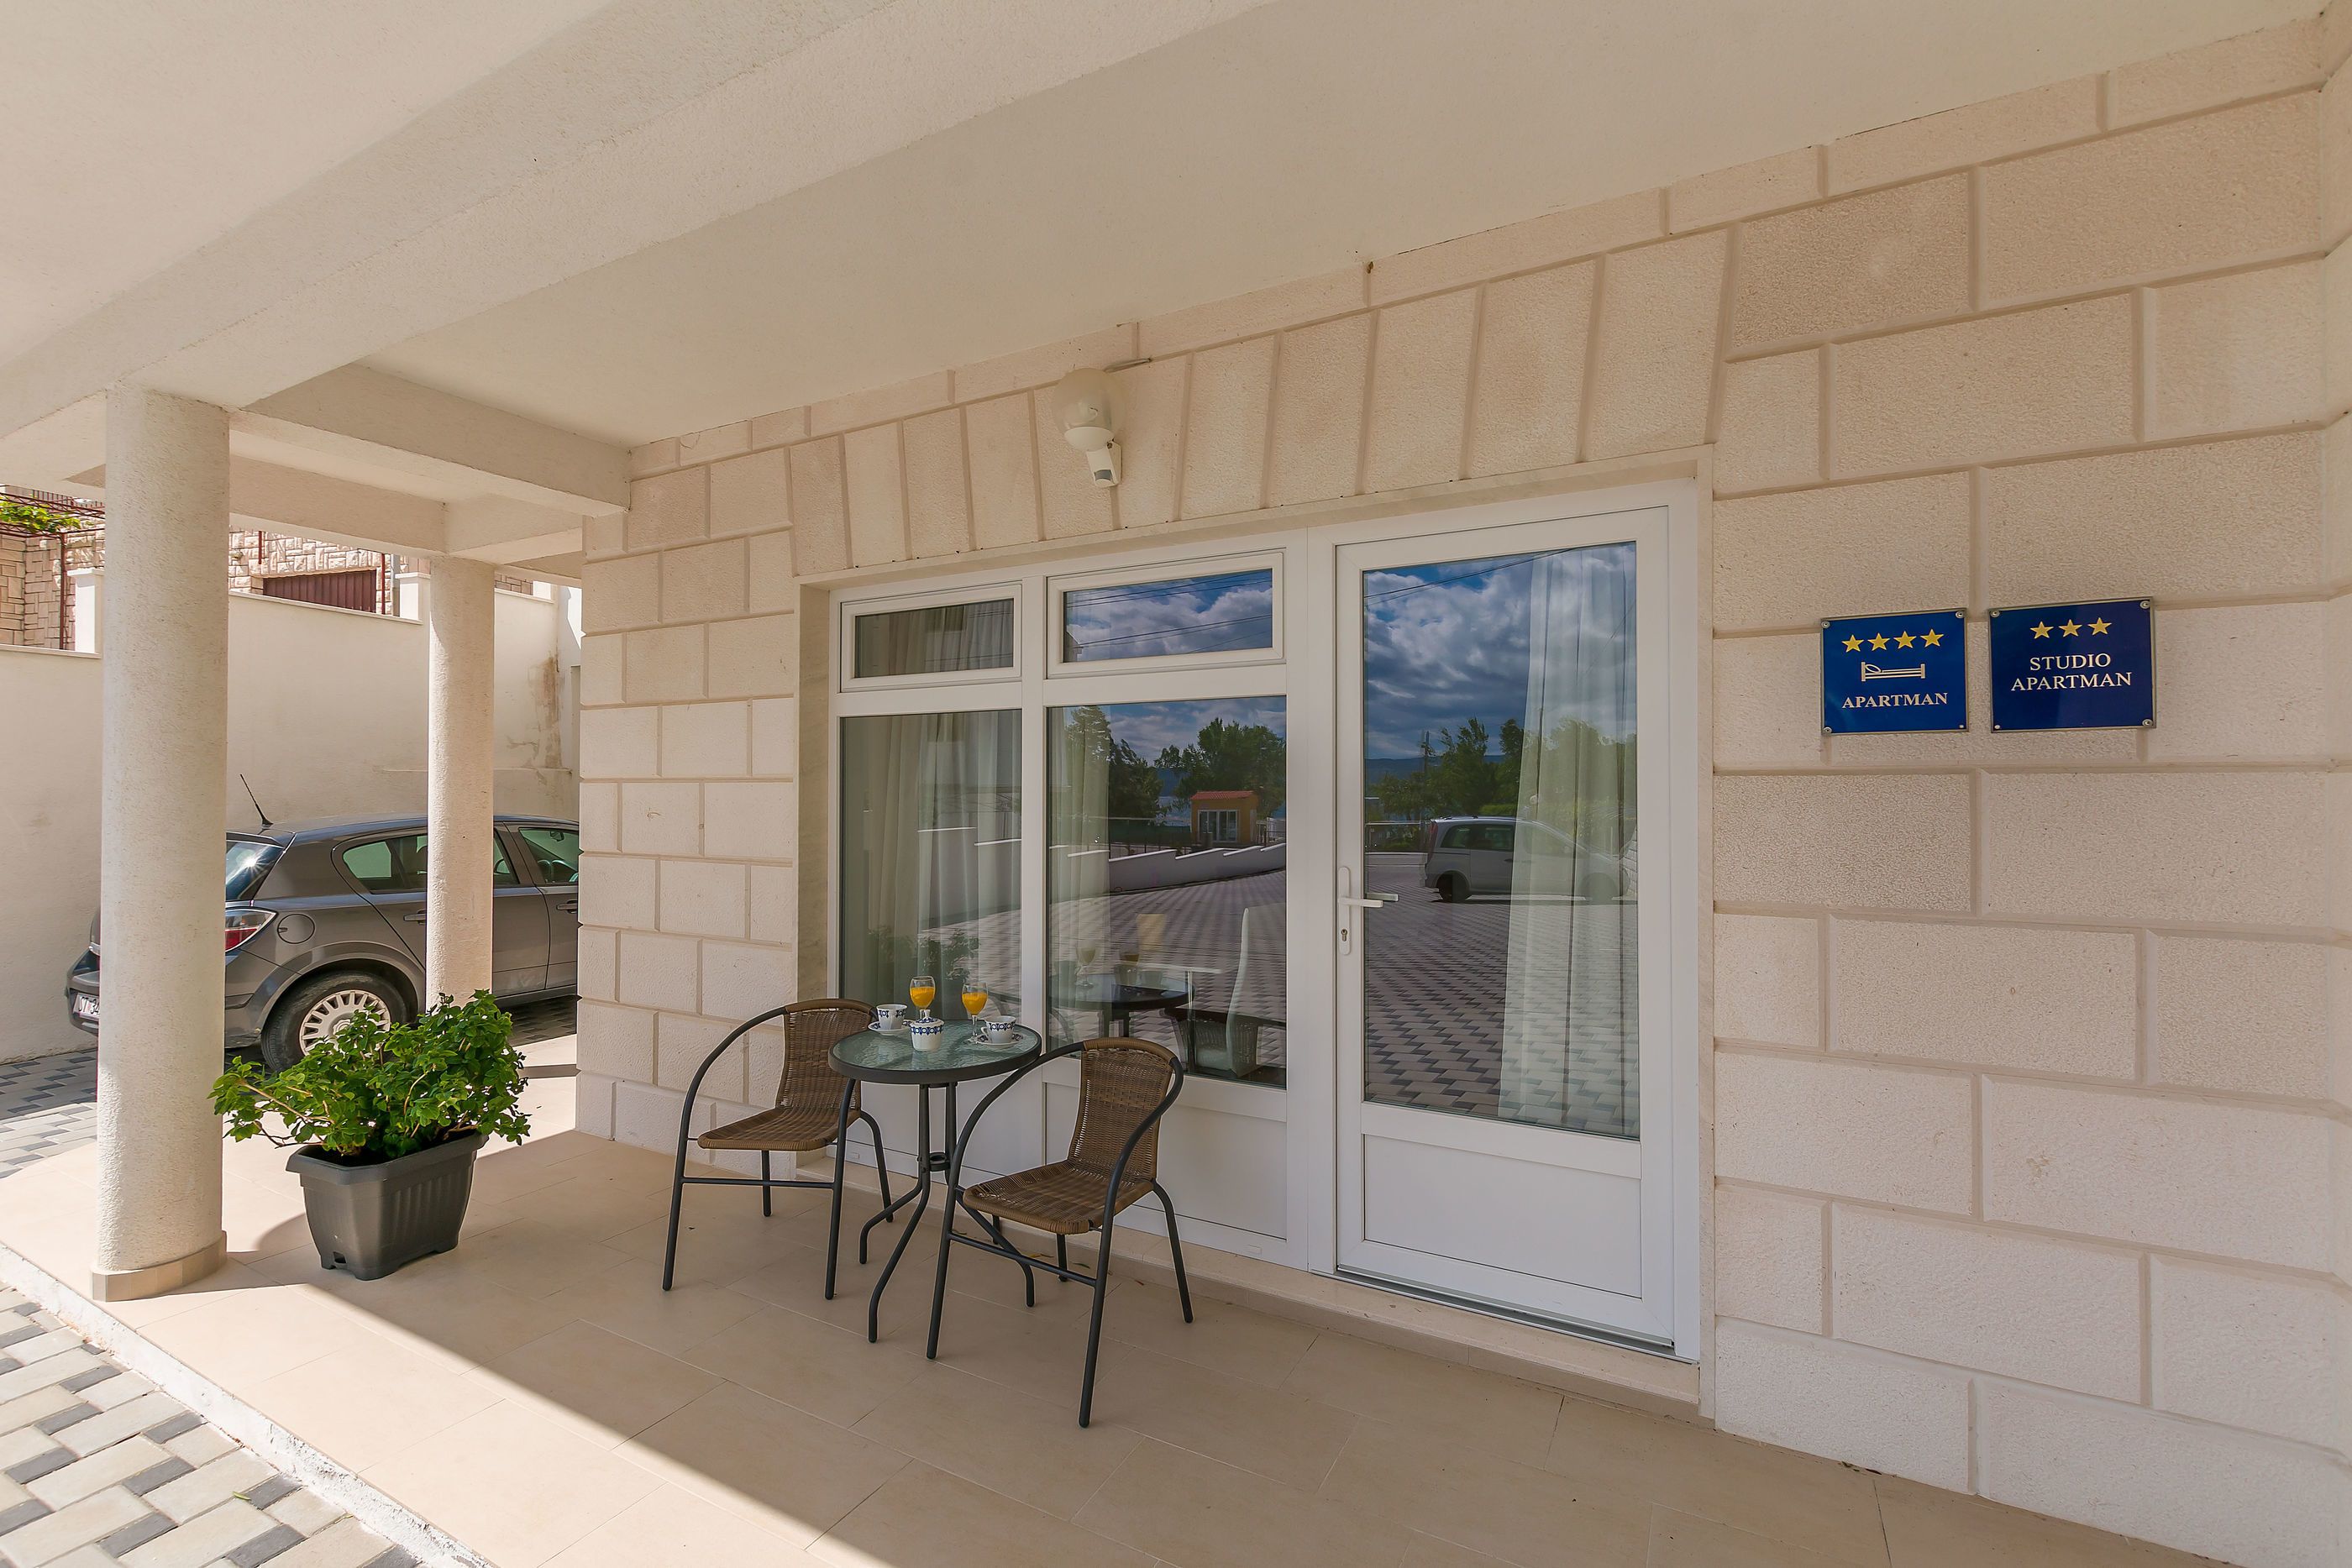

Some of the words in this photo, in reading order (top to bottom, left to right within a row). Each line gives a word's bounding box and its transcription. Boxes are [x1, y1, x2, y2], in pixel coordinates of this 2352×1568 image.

[2029, 653, 2112, 671] STUDIO
[2010, 671, 2133, 691] APARTMAN
[1841, 692, 1949, 709] APARTMAN
